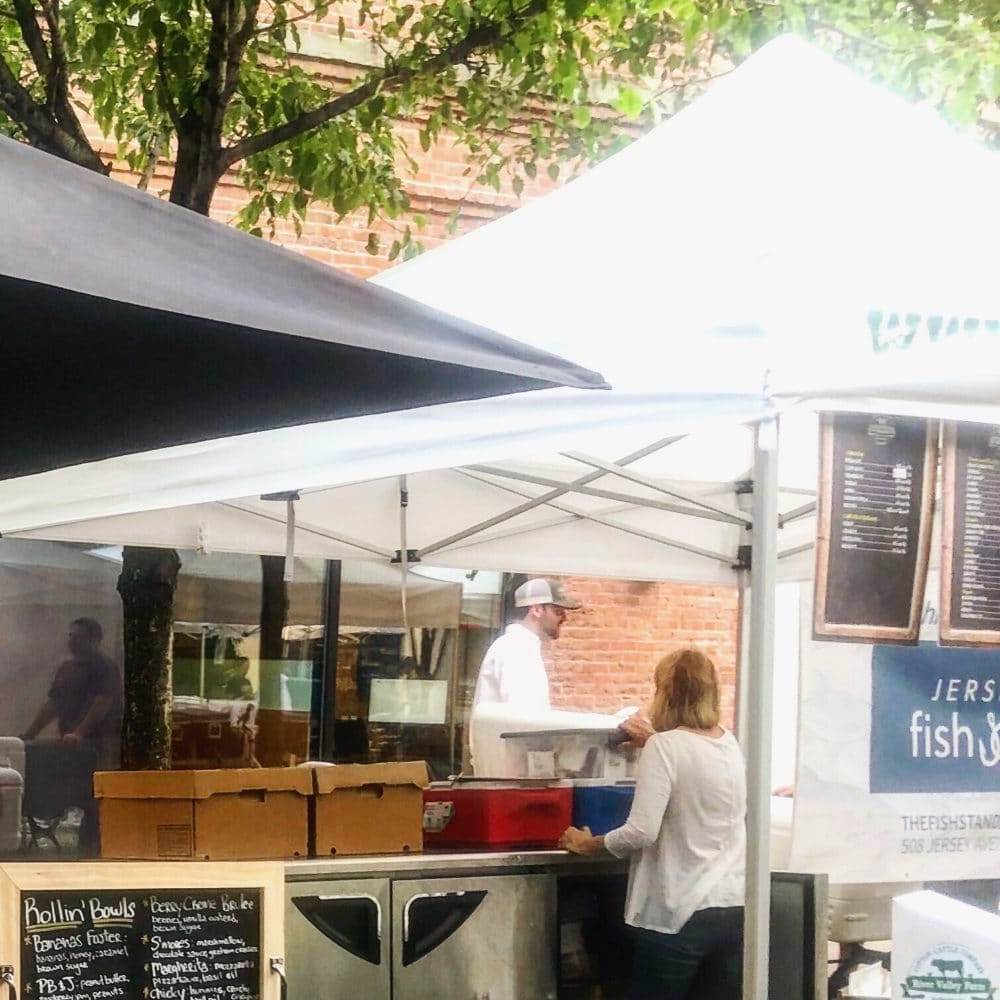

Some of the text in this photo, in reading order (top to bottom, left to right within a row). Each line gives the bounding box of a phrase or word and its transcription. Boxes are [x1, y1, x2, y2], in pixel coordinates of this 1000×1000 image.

[931, 678, 1000, 702] JERS
[910, 709, 973, 757] fish
[24, 897, 136, 926] Rollin' Bowls
[32, 934, 83, 953] Bananas
